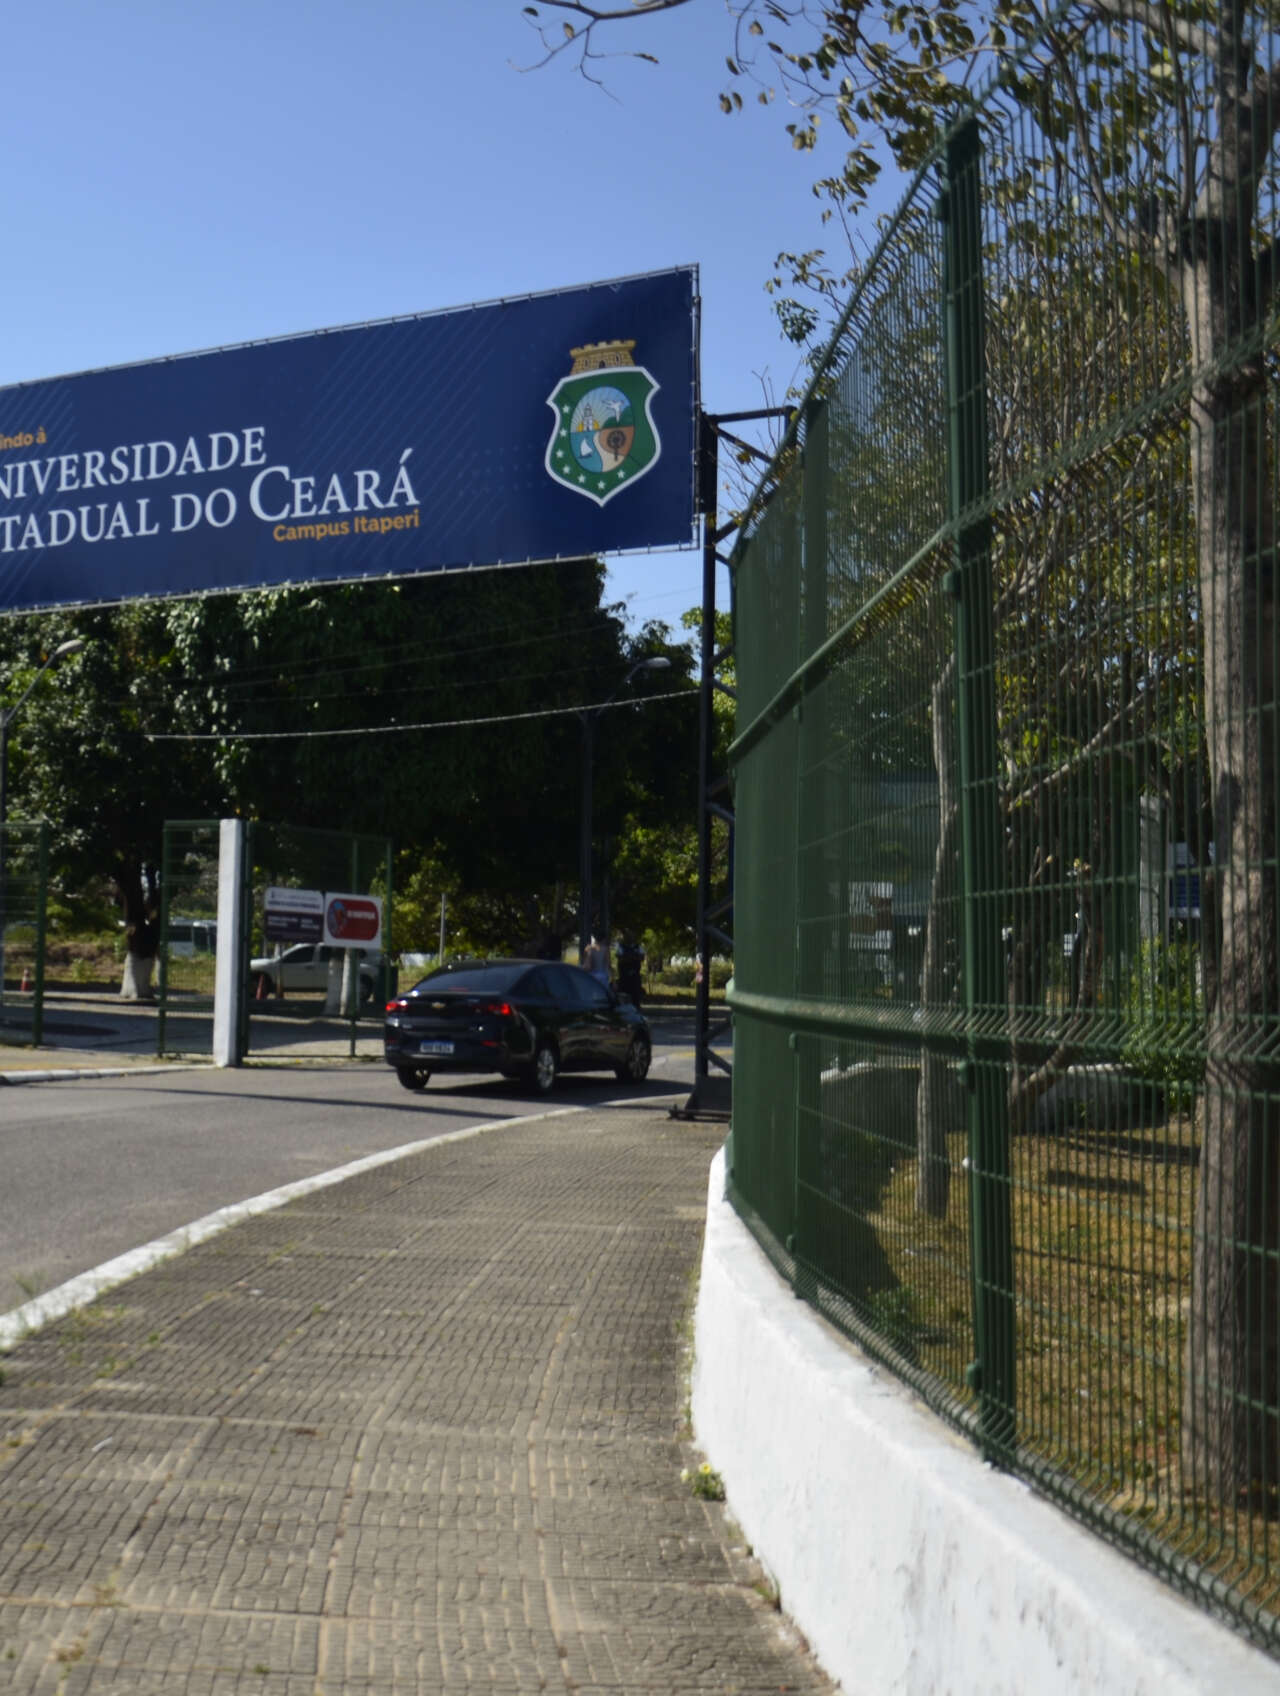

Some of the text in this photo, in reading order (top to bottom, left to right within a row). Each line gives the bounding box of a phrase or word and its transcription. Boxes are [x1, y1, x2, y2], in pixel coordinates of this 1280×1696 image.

[36, 426, 47, 444] à
[171, 488, 237, 533] DO
[249, 447, 421, 522] CEARÁ
[273, 509, 420, 542] Campus Itaperi
